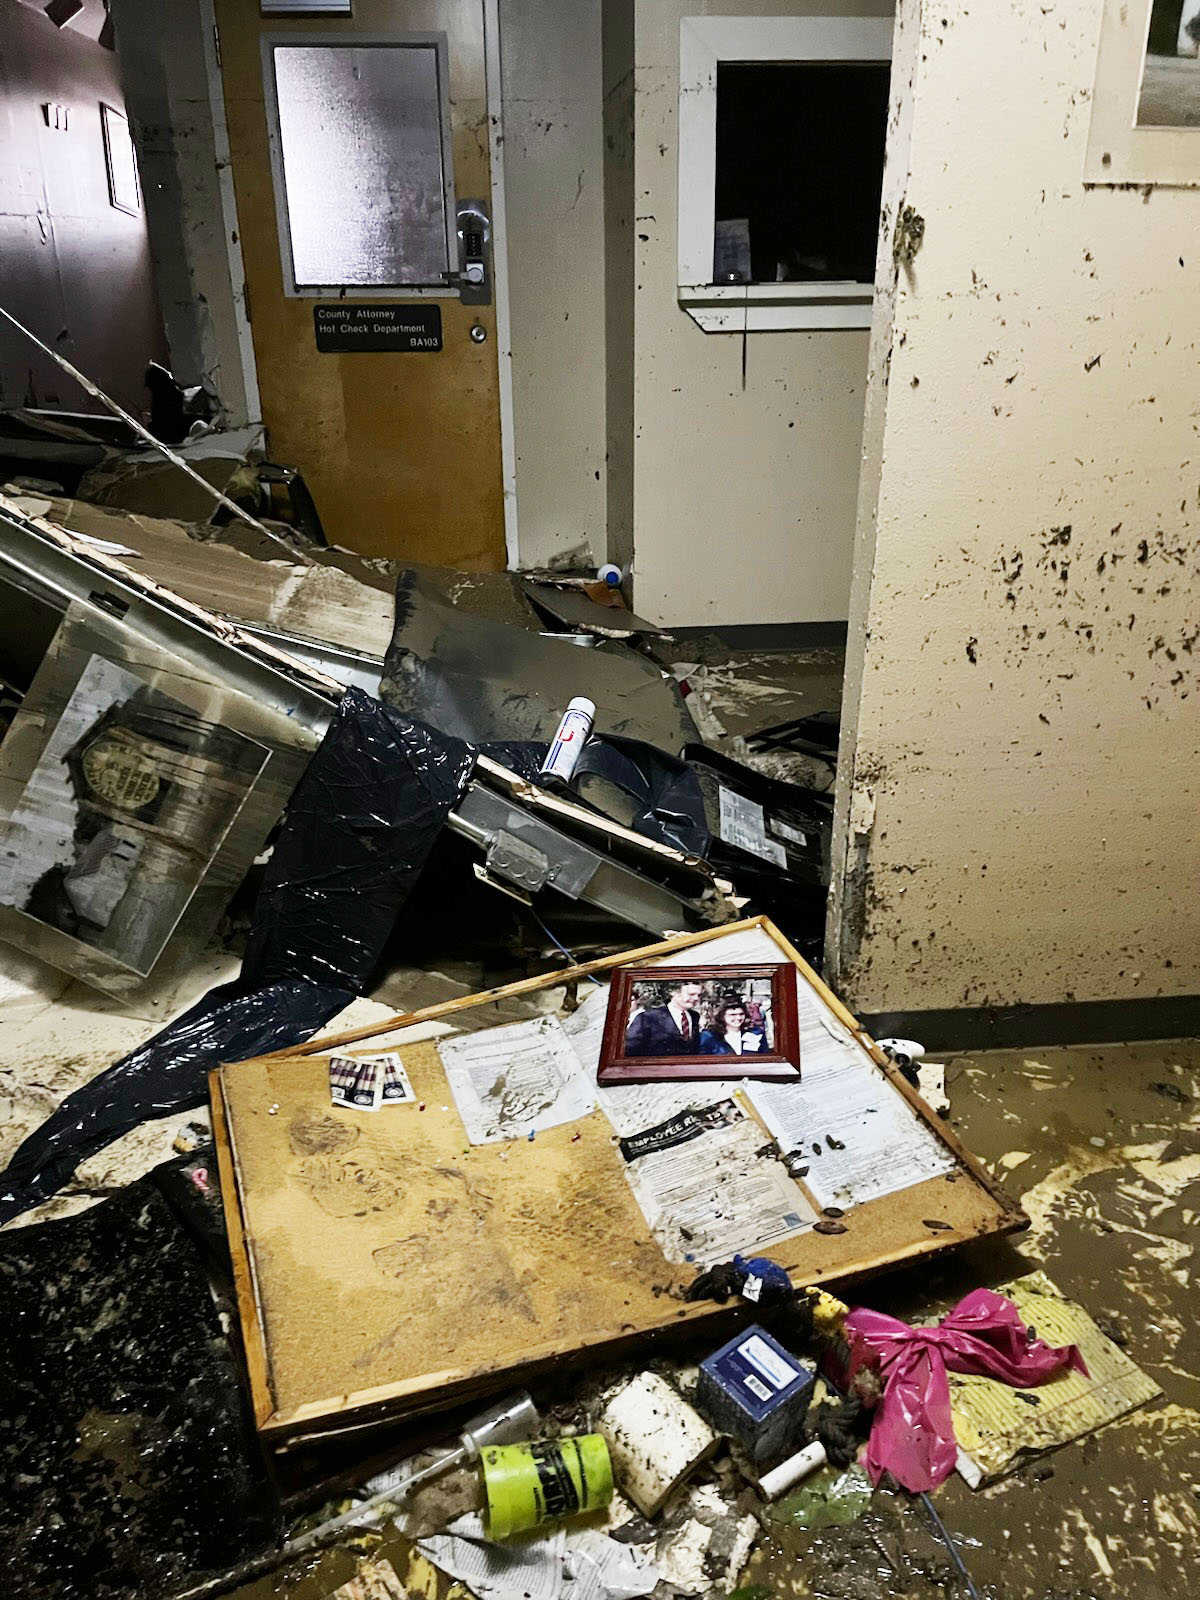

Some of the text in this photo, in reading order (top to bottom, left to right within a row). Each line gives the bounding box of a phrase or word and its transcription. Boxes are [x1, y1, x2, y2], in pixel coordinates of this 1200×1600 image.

[318, 309, 395, 320] County Attorney
[319, 324, 425, 334] Hot Check Department
[410, 338, 439, 347] BA103
[627, 1123, 684, 1149] EMPLOYEE
